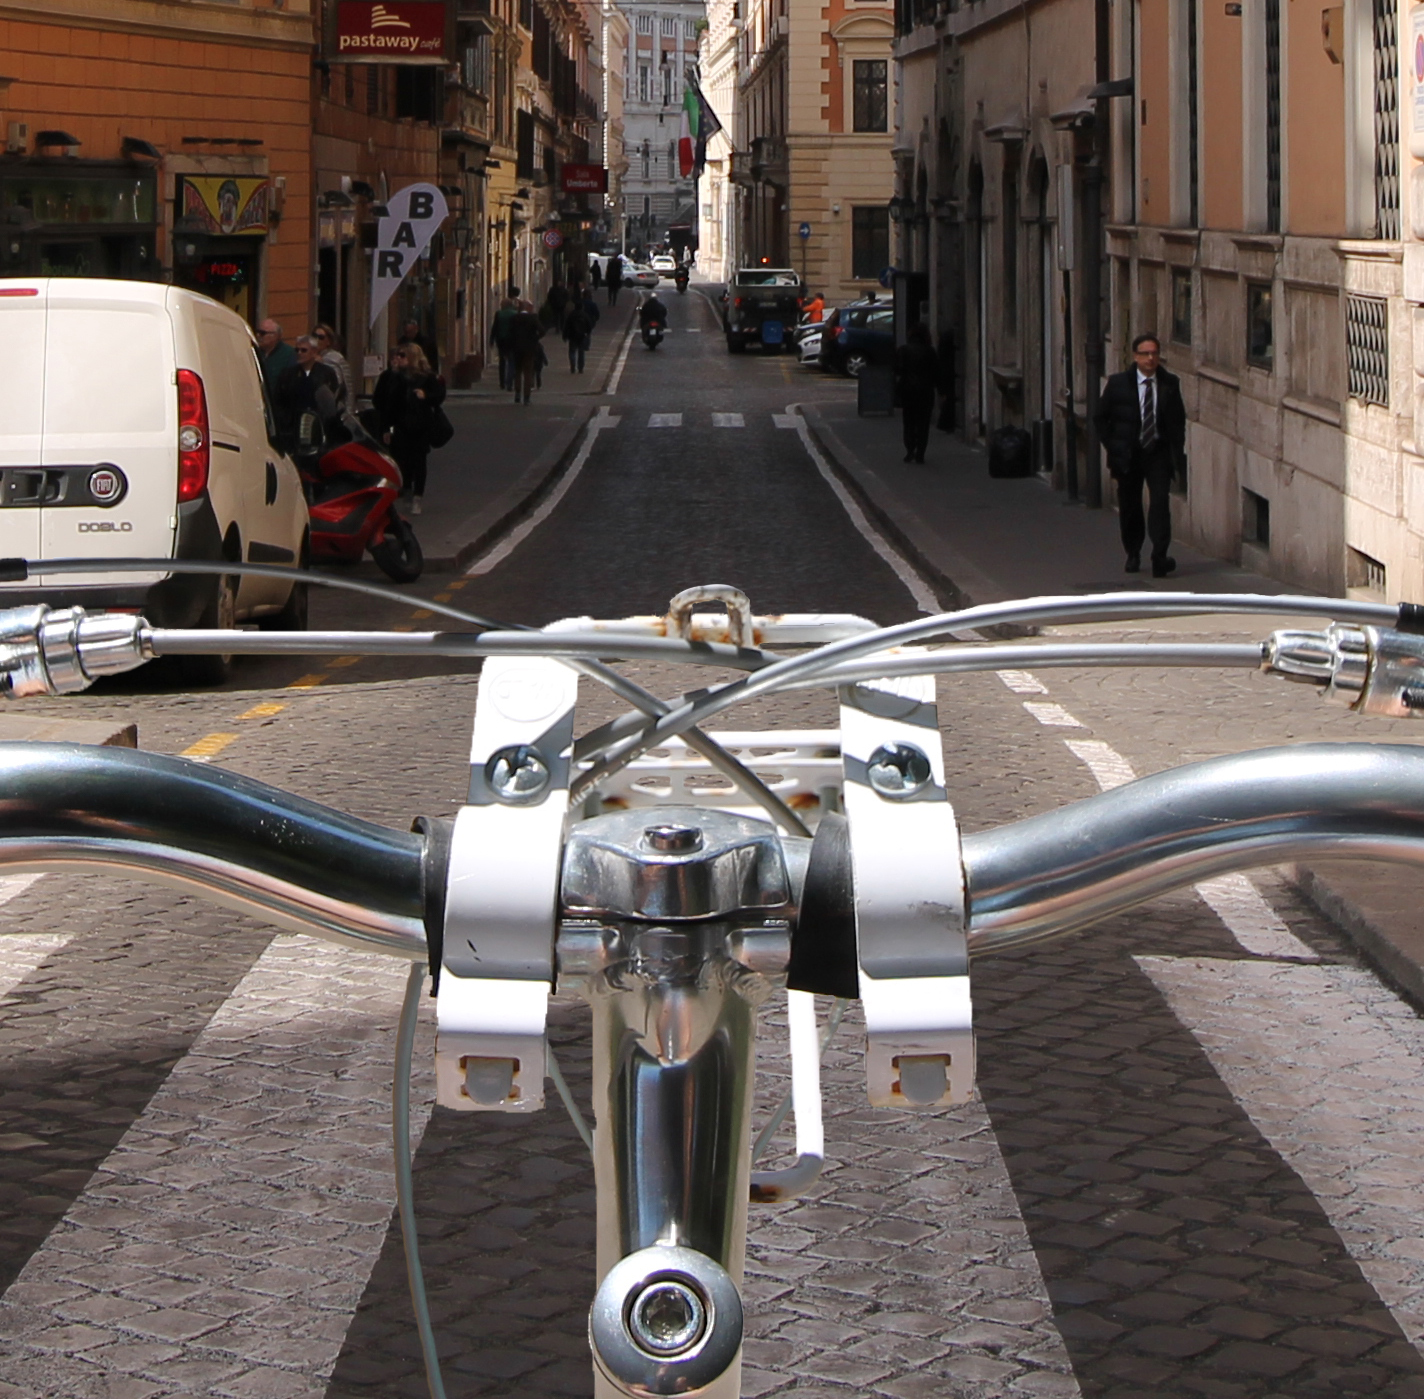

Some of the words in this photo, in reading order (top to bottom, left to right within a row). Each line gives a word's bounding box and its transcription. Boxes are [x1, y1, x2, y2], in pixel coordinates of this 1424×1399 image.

[339, 33, 420, 51] pastaway
[420, 37, 441, 50] café
[566, 180, 598, 188] Umberto
[377, 191, 434, 278] BAR
[210, 263, 238, 276] PIZZA
[96, 477, 113, 492] FIAT
